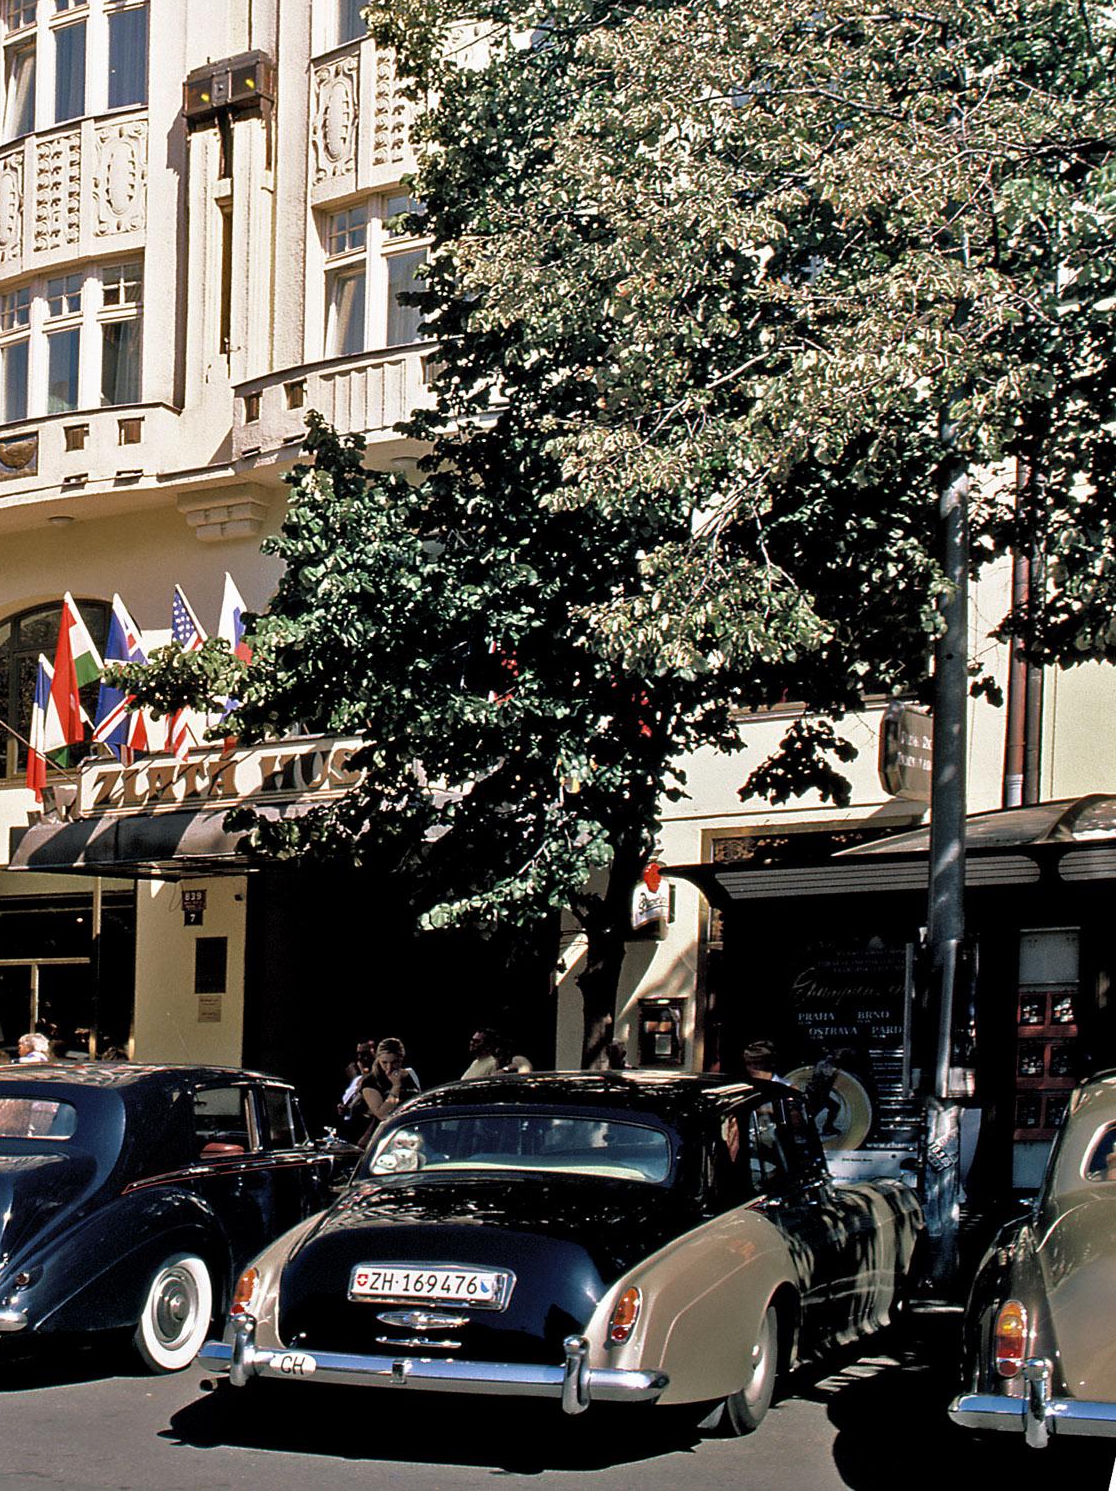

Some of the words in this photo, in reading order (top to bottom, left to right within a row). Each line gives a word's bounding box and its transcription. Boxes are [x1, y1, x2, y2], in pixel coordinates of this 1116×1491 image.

[190, 913, 196, 923] 7
[798, 1012, 835, 1021] PRAHA
[857, 1011, 890, 1020] BRNO
[809, 1027, 858, 1035] OSTRAVA
[872, 1026, 904, 1034] PARD
[280, 1355, 305, 1375] CH
